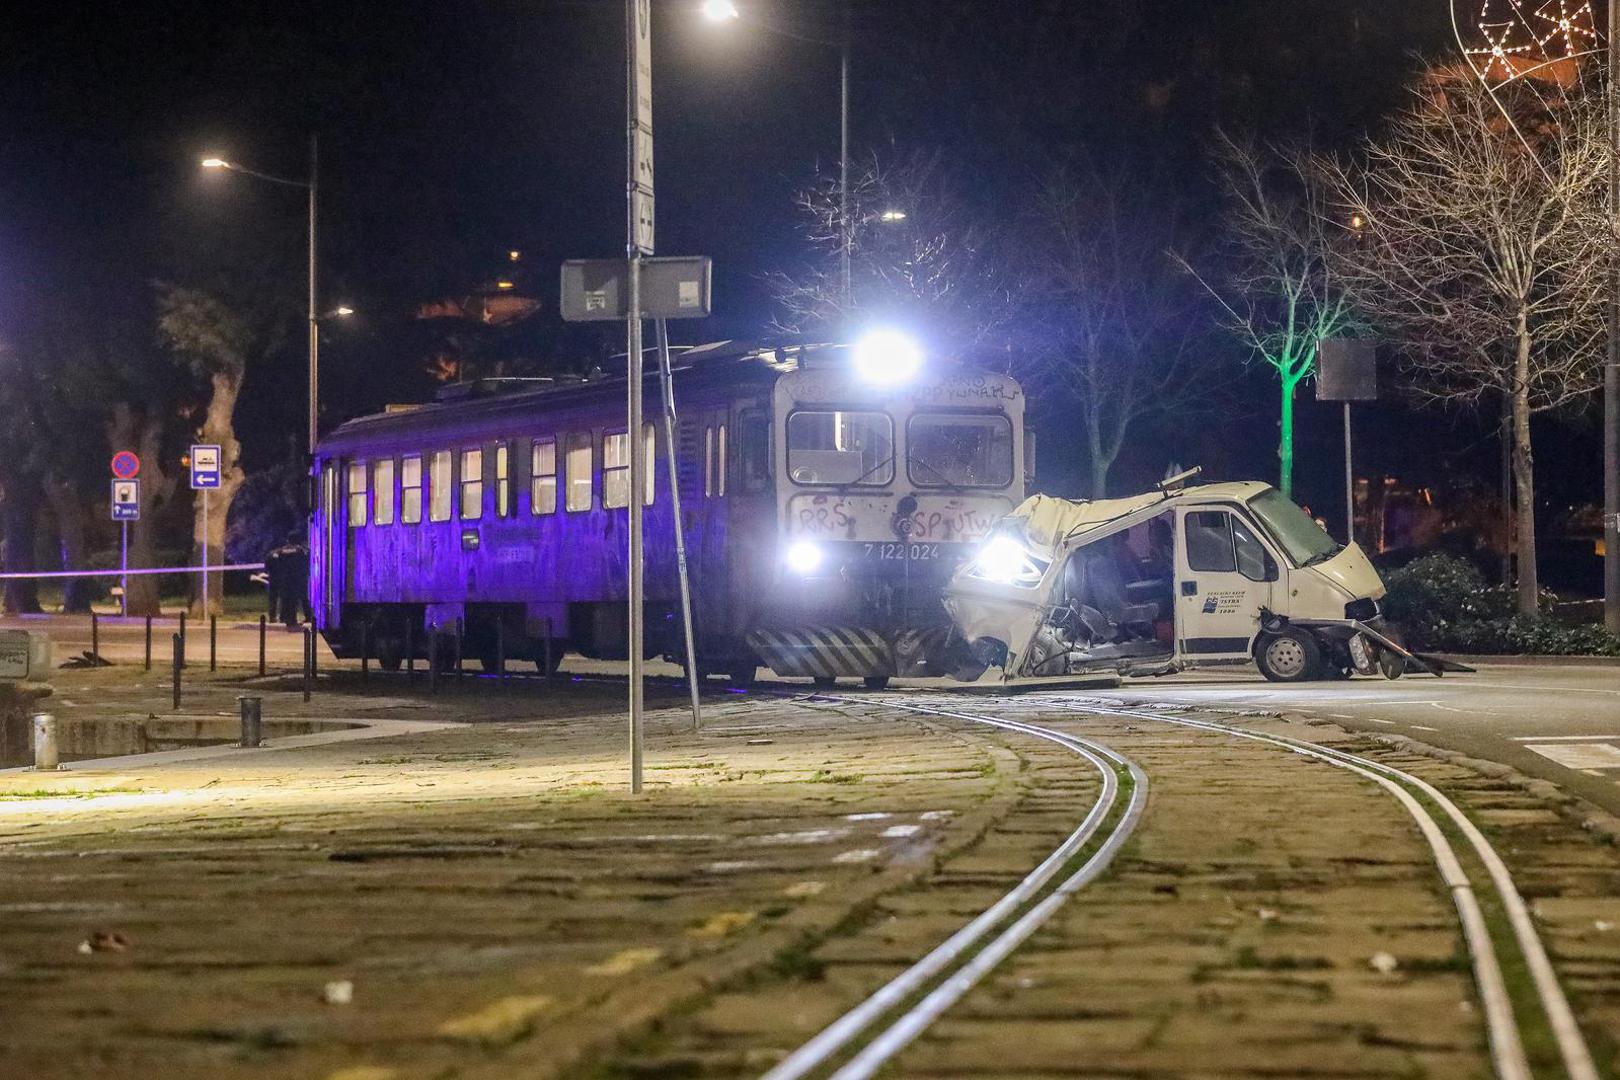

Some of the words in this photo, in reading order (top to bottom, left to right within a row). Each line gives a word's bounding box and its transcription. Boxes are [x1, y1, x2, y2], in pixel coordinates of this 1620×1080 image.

[864, 543, 874, 560] 7
[880, 543, 904, 560] 122
[910, 544, 939, 560] 024
